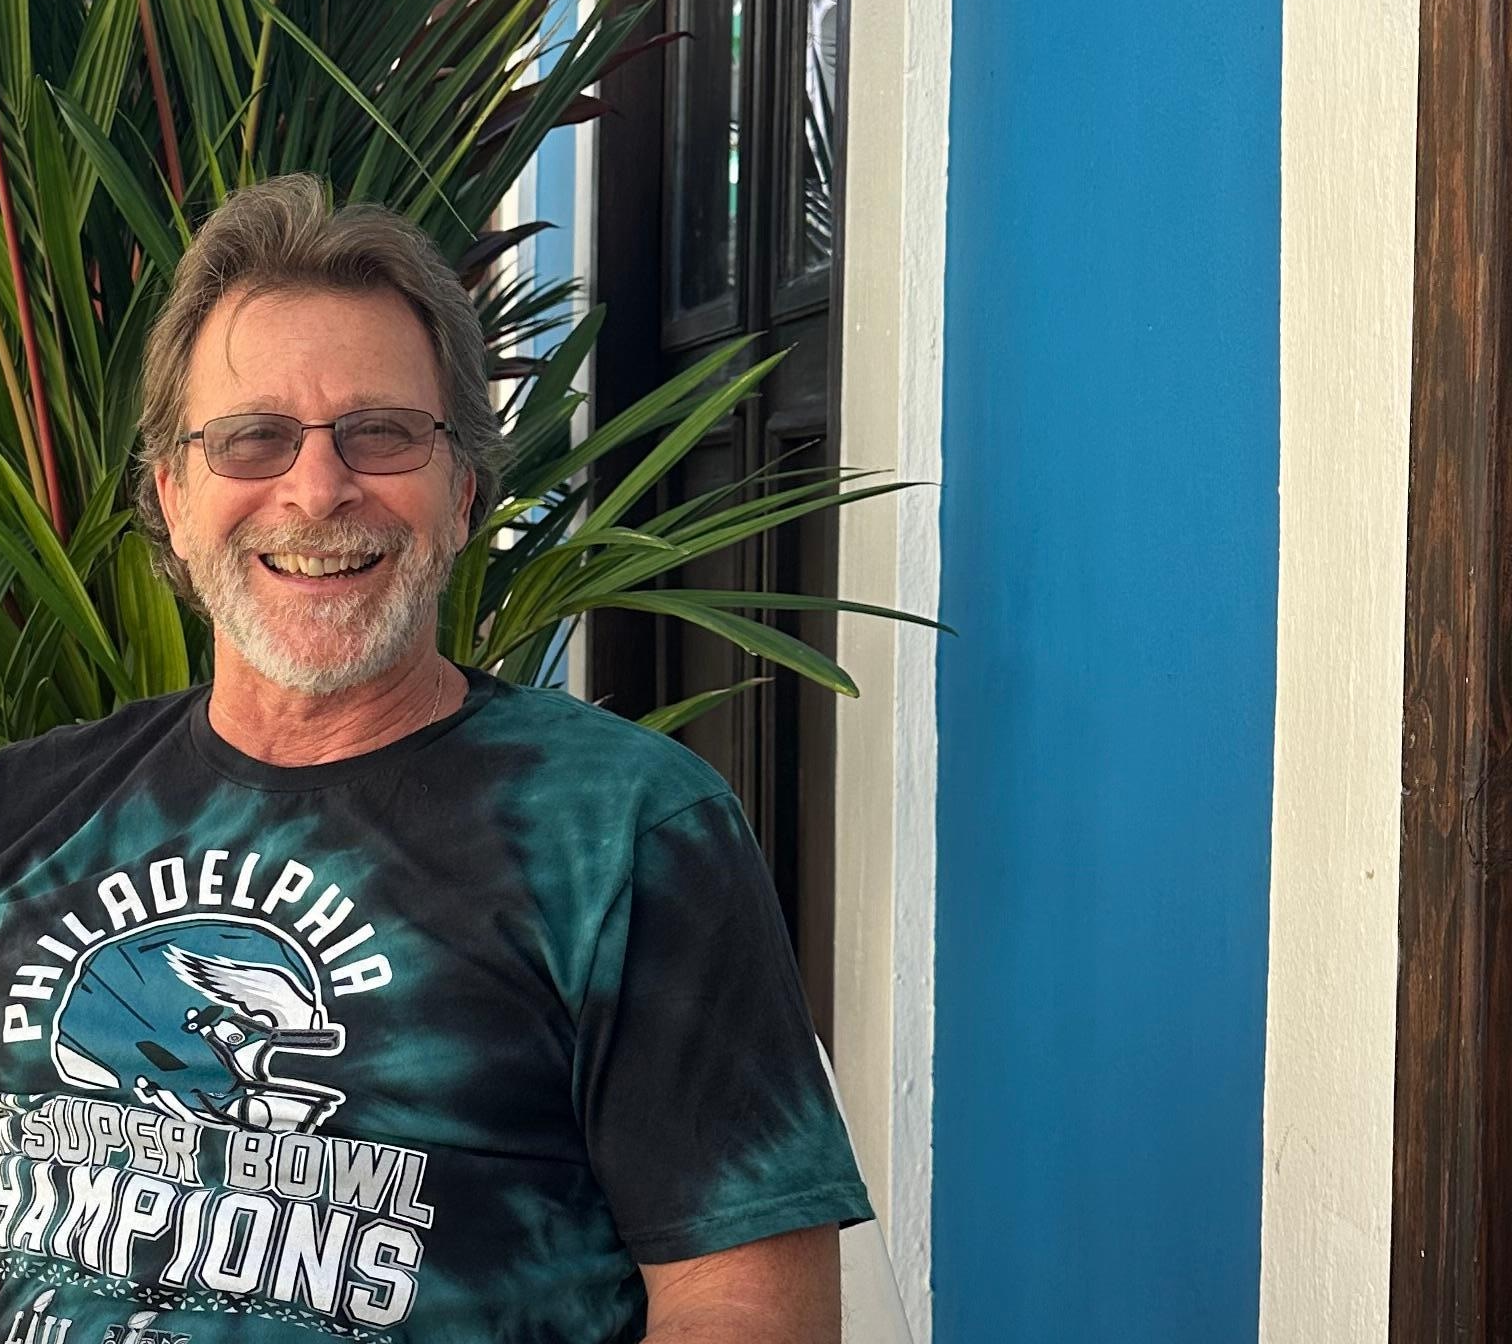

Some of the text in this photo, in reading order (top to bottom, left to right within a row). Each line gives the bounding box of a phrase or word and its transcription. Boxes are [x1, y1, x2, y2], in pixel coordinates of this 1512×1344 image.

[2, 849, 393, 1044] PHILADELPHIA
[20, 1095, 204, 1188] SUPER
[223, 1130, 435, 1229] BOWL
